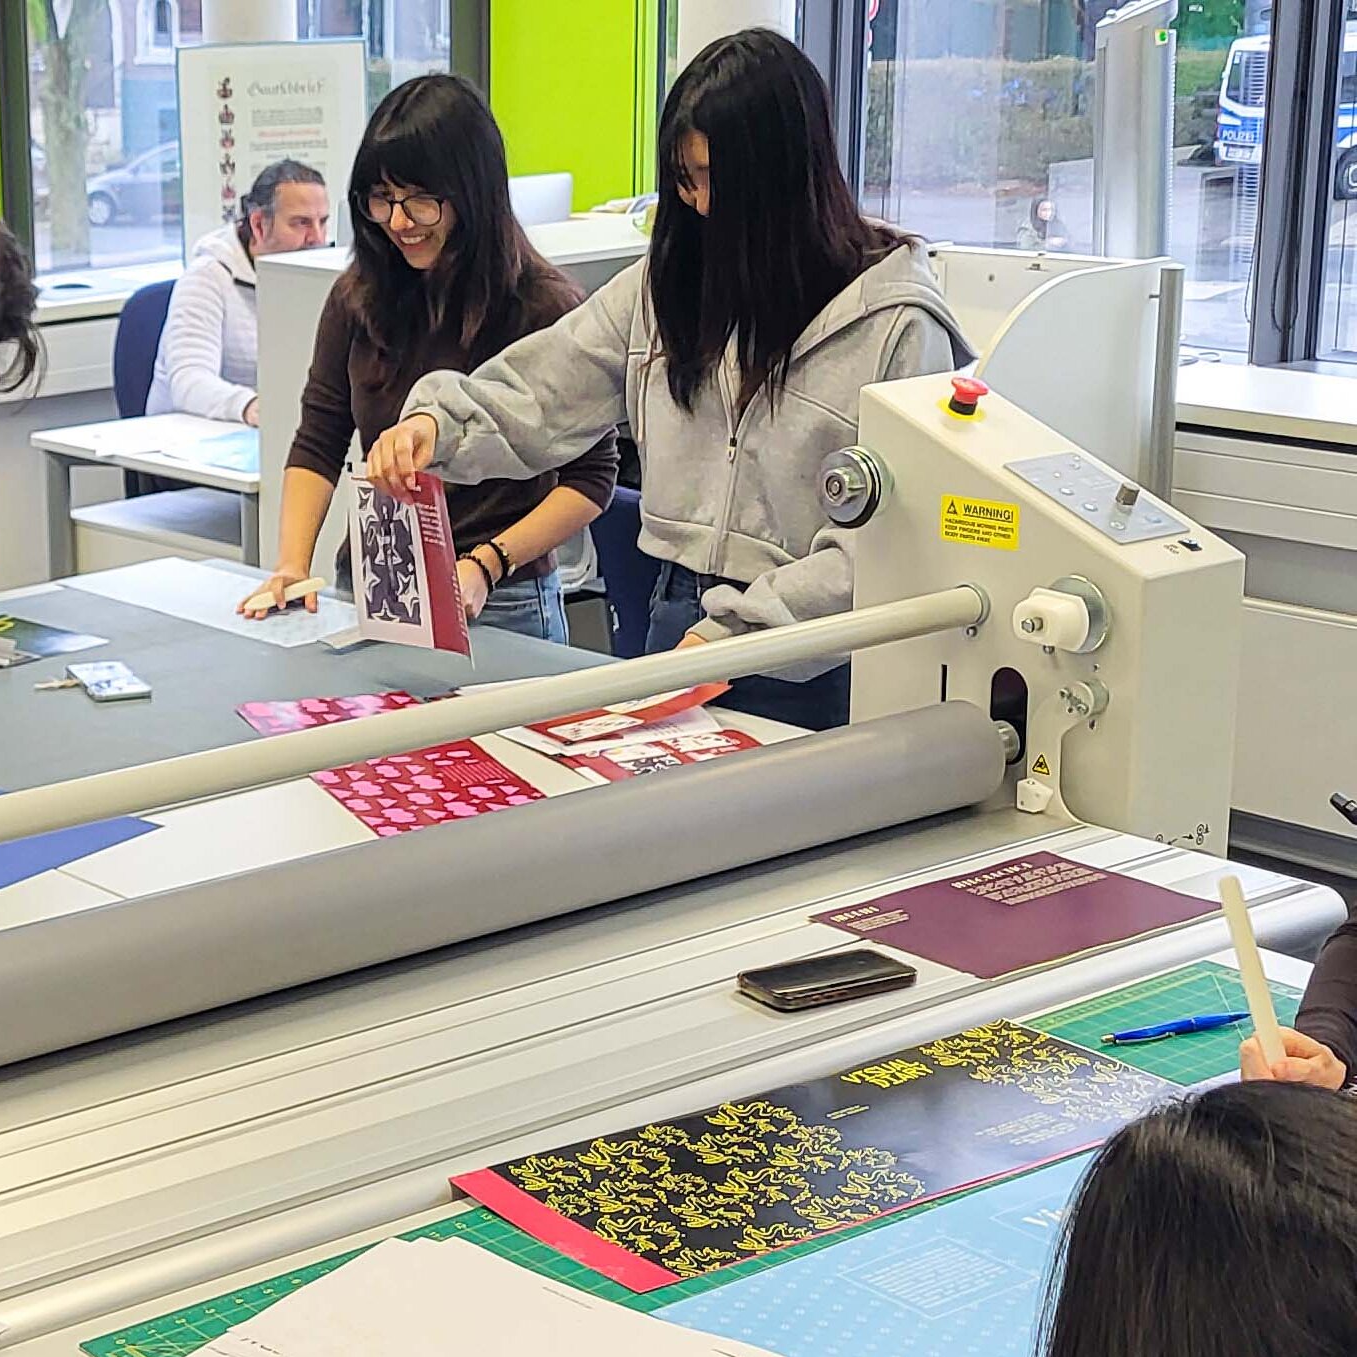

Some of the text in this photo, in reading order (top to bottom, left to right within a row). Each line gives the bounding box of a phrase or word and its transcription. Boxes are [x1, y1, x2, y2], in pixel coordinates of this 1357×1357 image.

[963, 503, 1014, 521] WARNING!
[841, 1059, 921, 1084] VISUAL
[869, 1063, 934, 1088] DIARY
